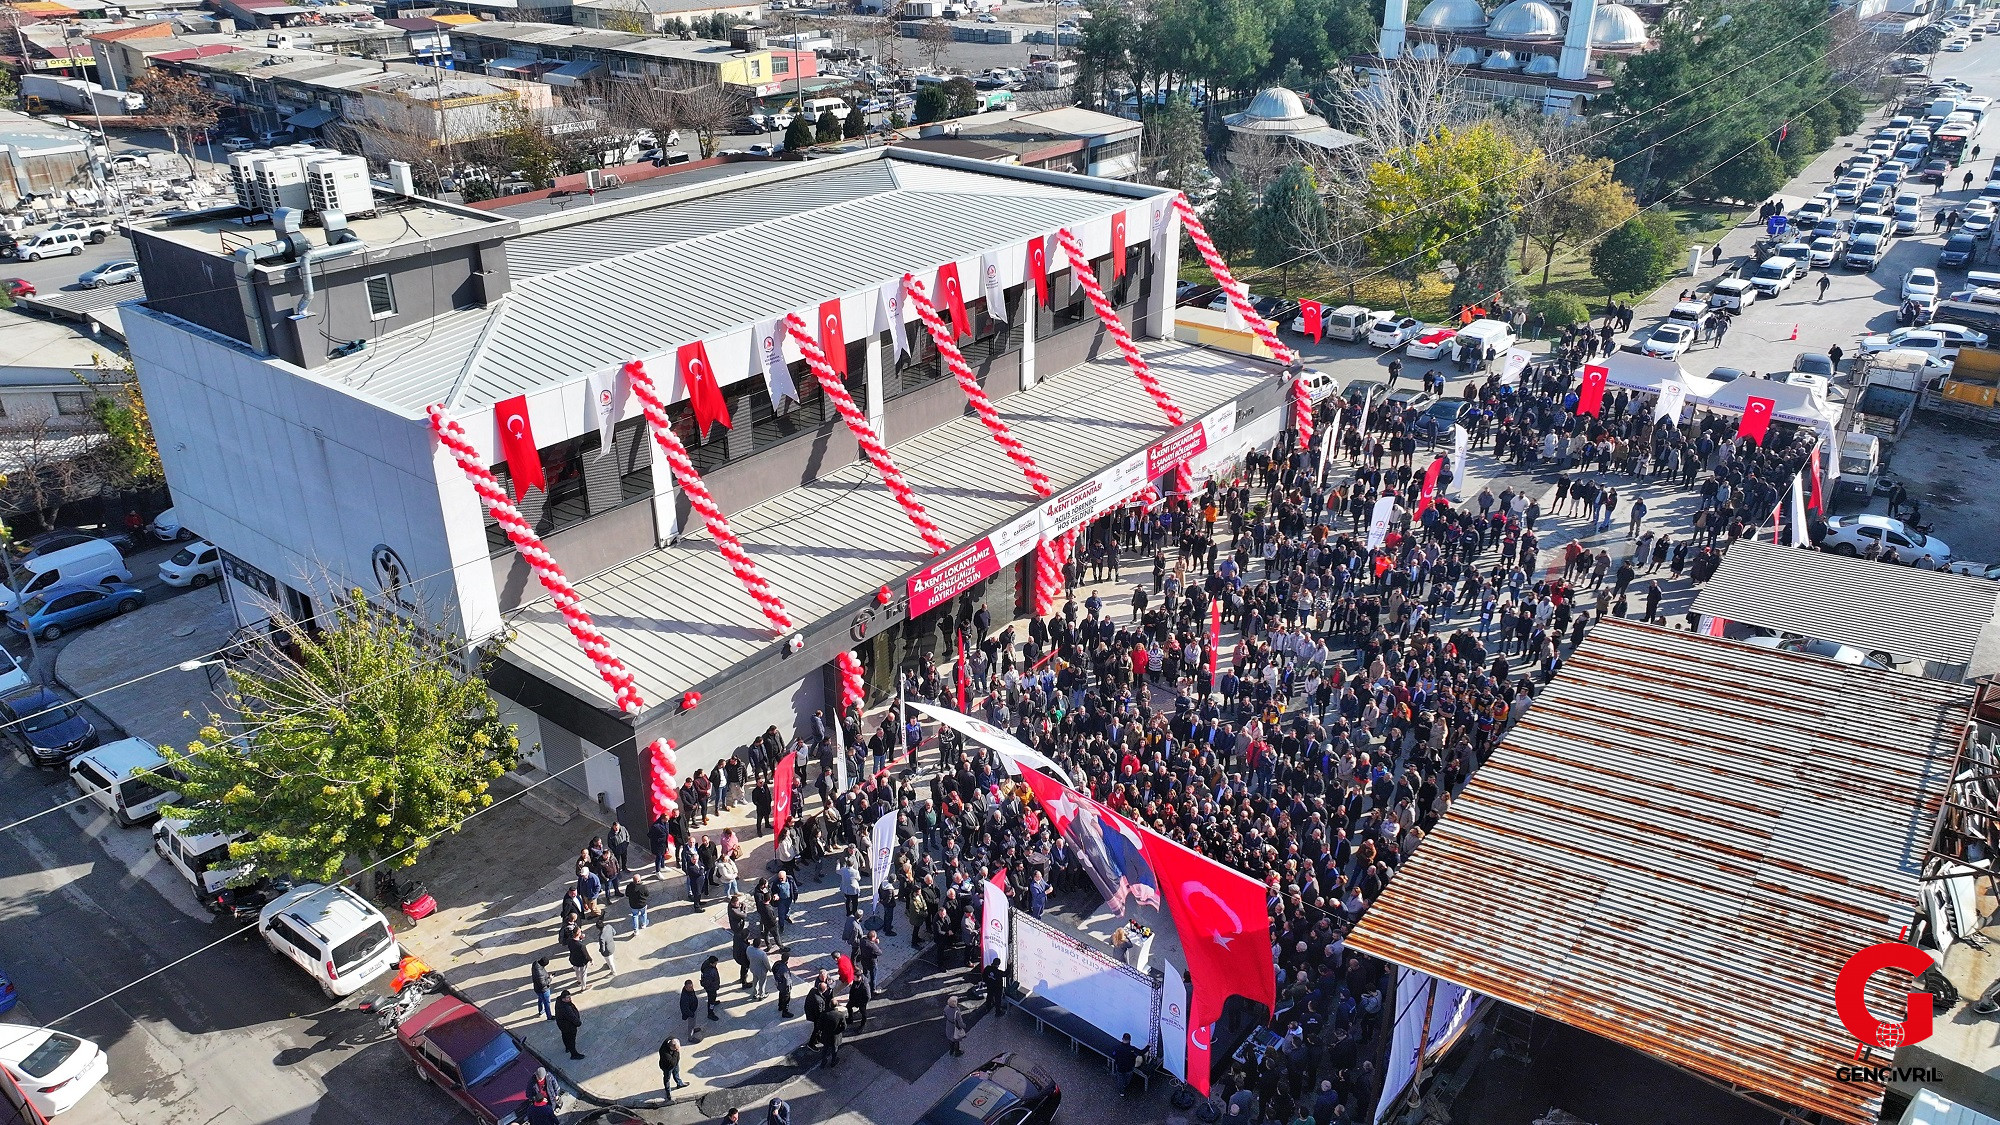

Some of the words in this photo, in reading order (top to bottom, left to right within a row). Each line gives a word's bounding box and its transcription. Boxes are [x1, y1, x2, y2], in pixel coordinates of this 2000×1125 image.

[1070, 483, 1102, 505] LOKANTASI
[1070, 507, 1094, 524] GELDİNİZ
[944, 547, 990, 578] LOKANTAMIZ
[928, 585, 956, 606] HAYIRLI
[957, 571, 981, 590] OLSUN
[933, 566, 976, 594] DENİZLİMİZE
